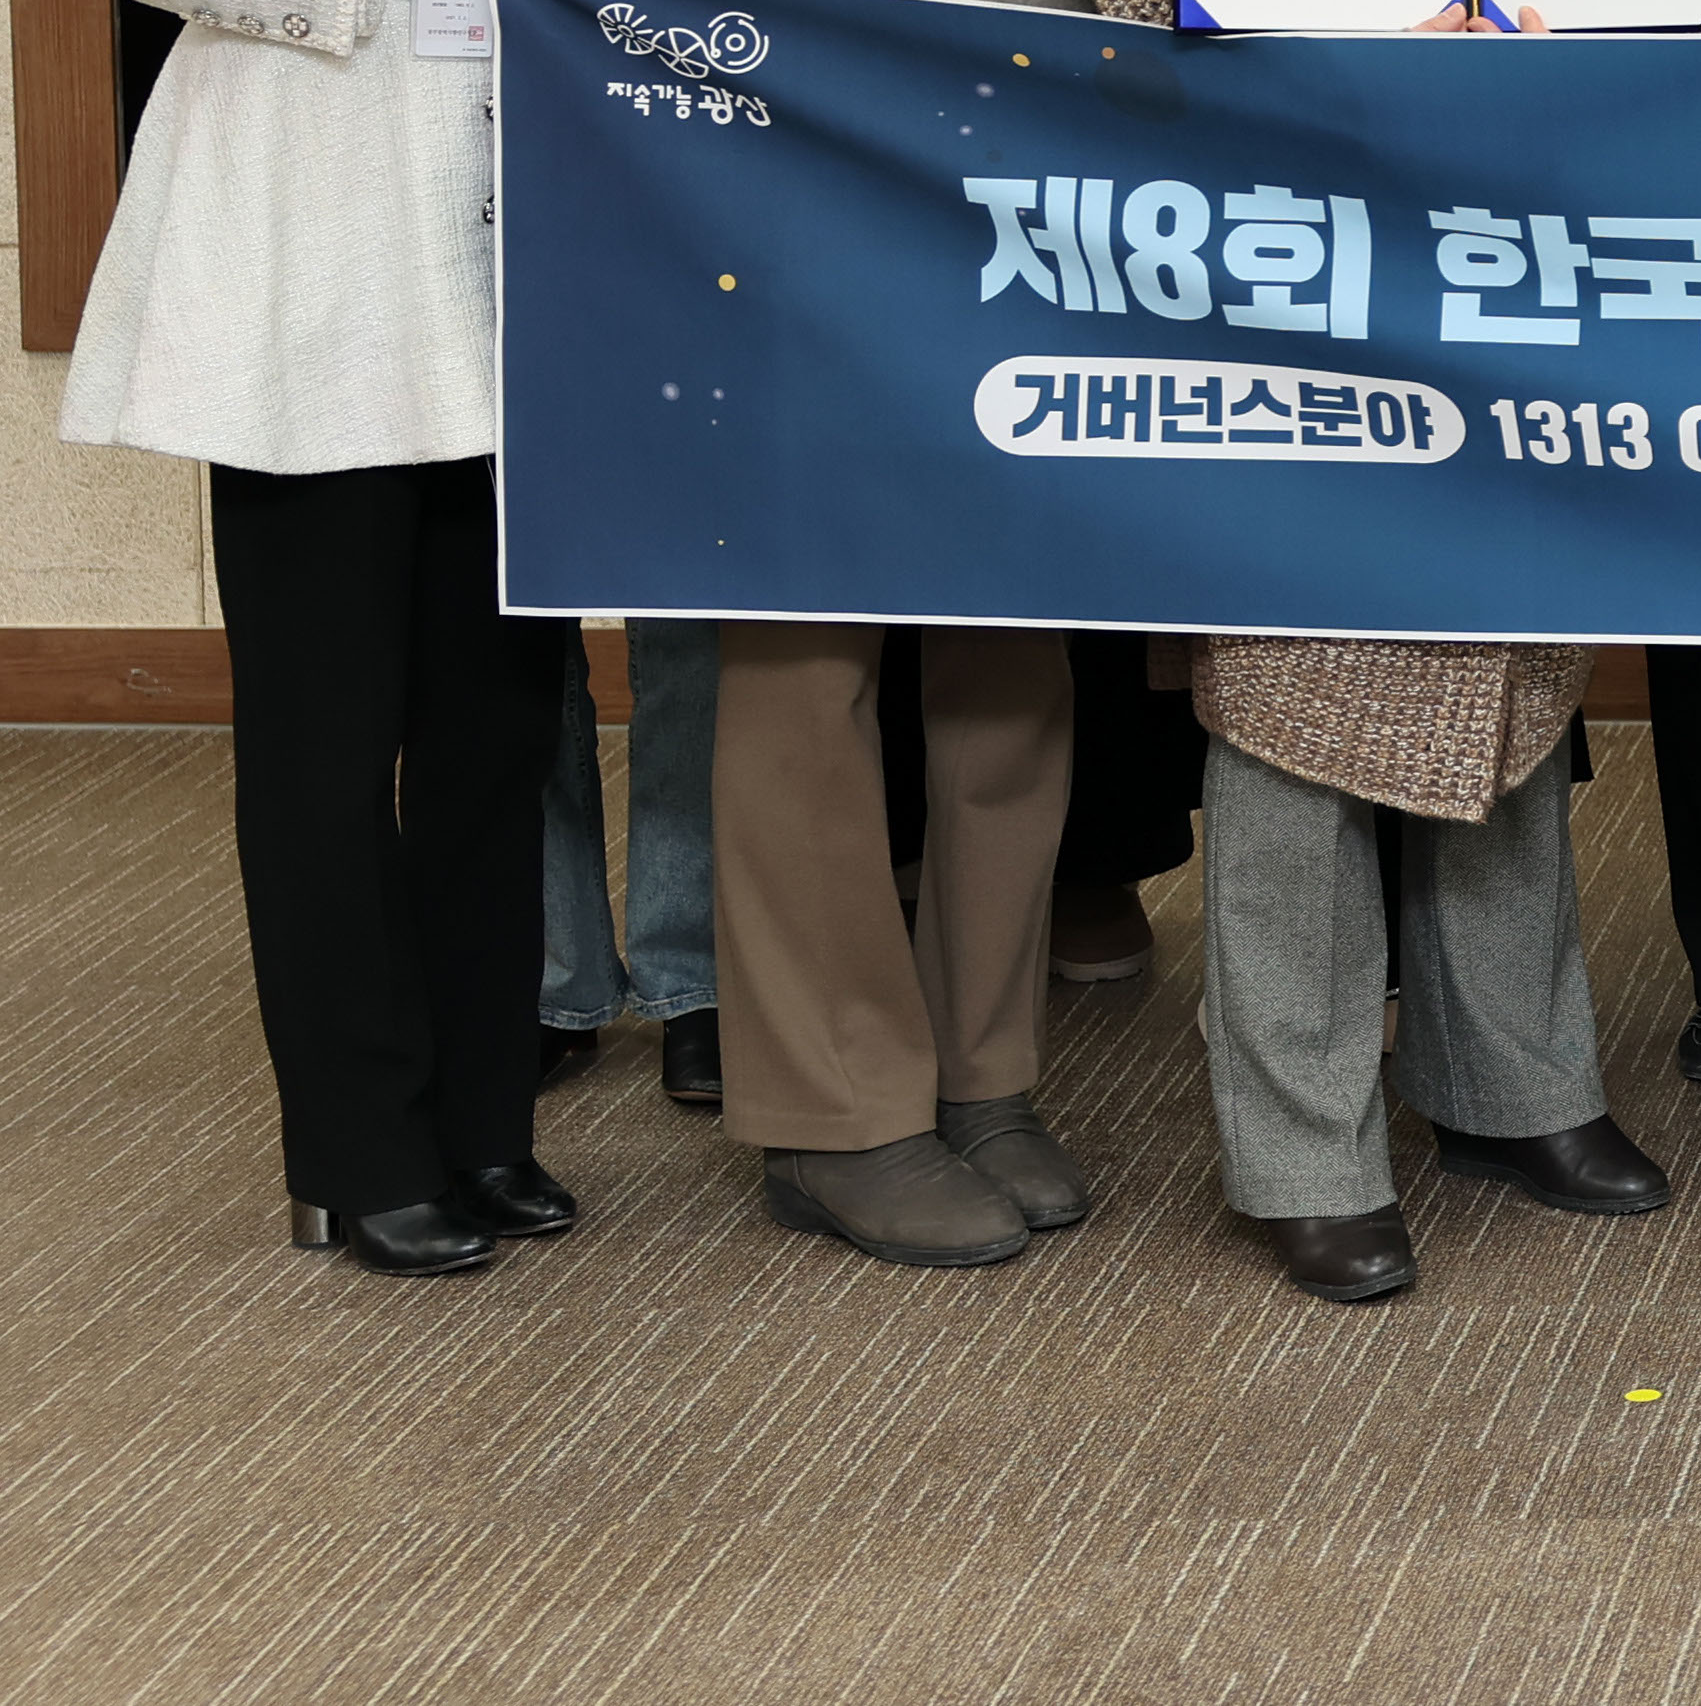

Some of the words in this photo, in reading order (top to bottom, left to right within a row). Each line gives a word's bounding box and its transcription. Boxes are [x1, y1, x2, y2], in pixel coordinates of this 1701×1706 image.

[606, 81, 692, 120] 지속가능
[697, 84, 772, 128] 광산
[962, 174, 1373, 341] 제8회
[1010, 371, 1436, 451] 거버넌스분야
[1489, 398, 1654, 471] 1313
